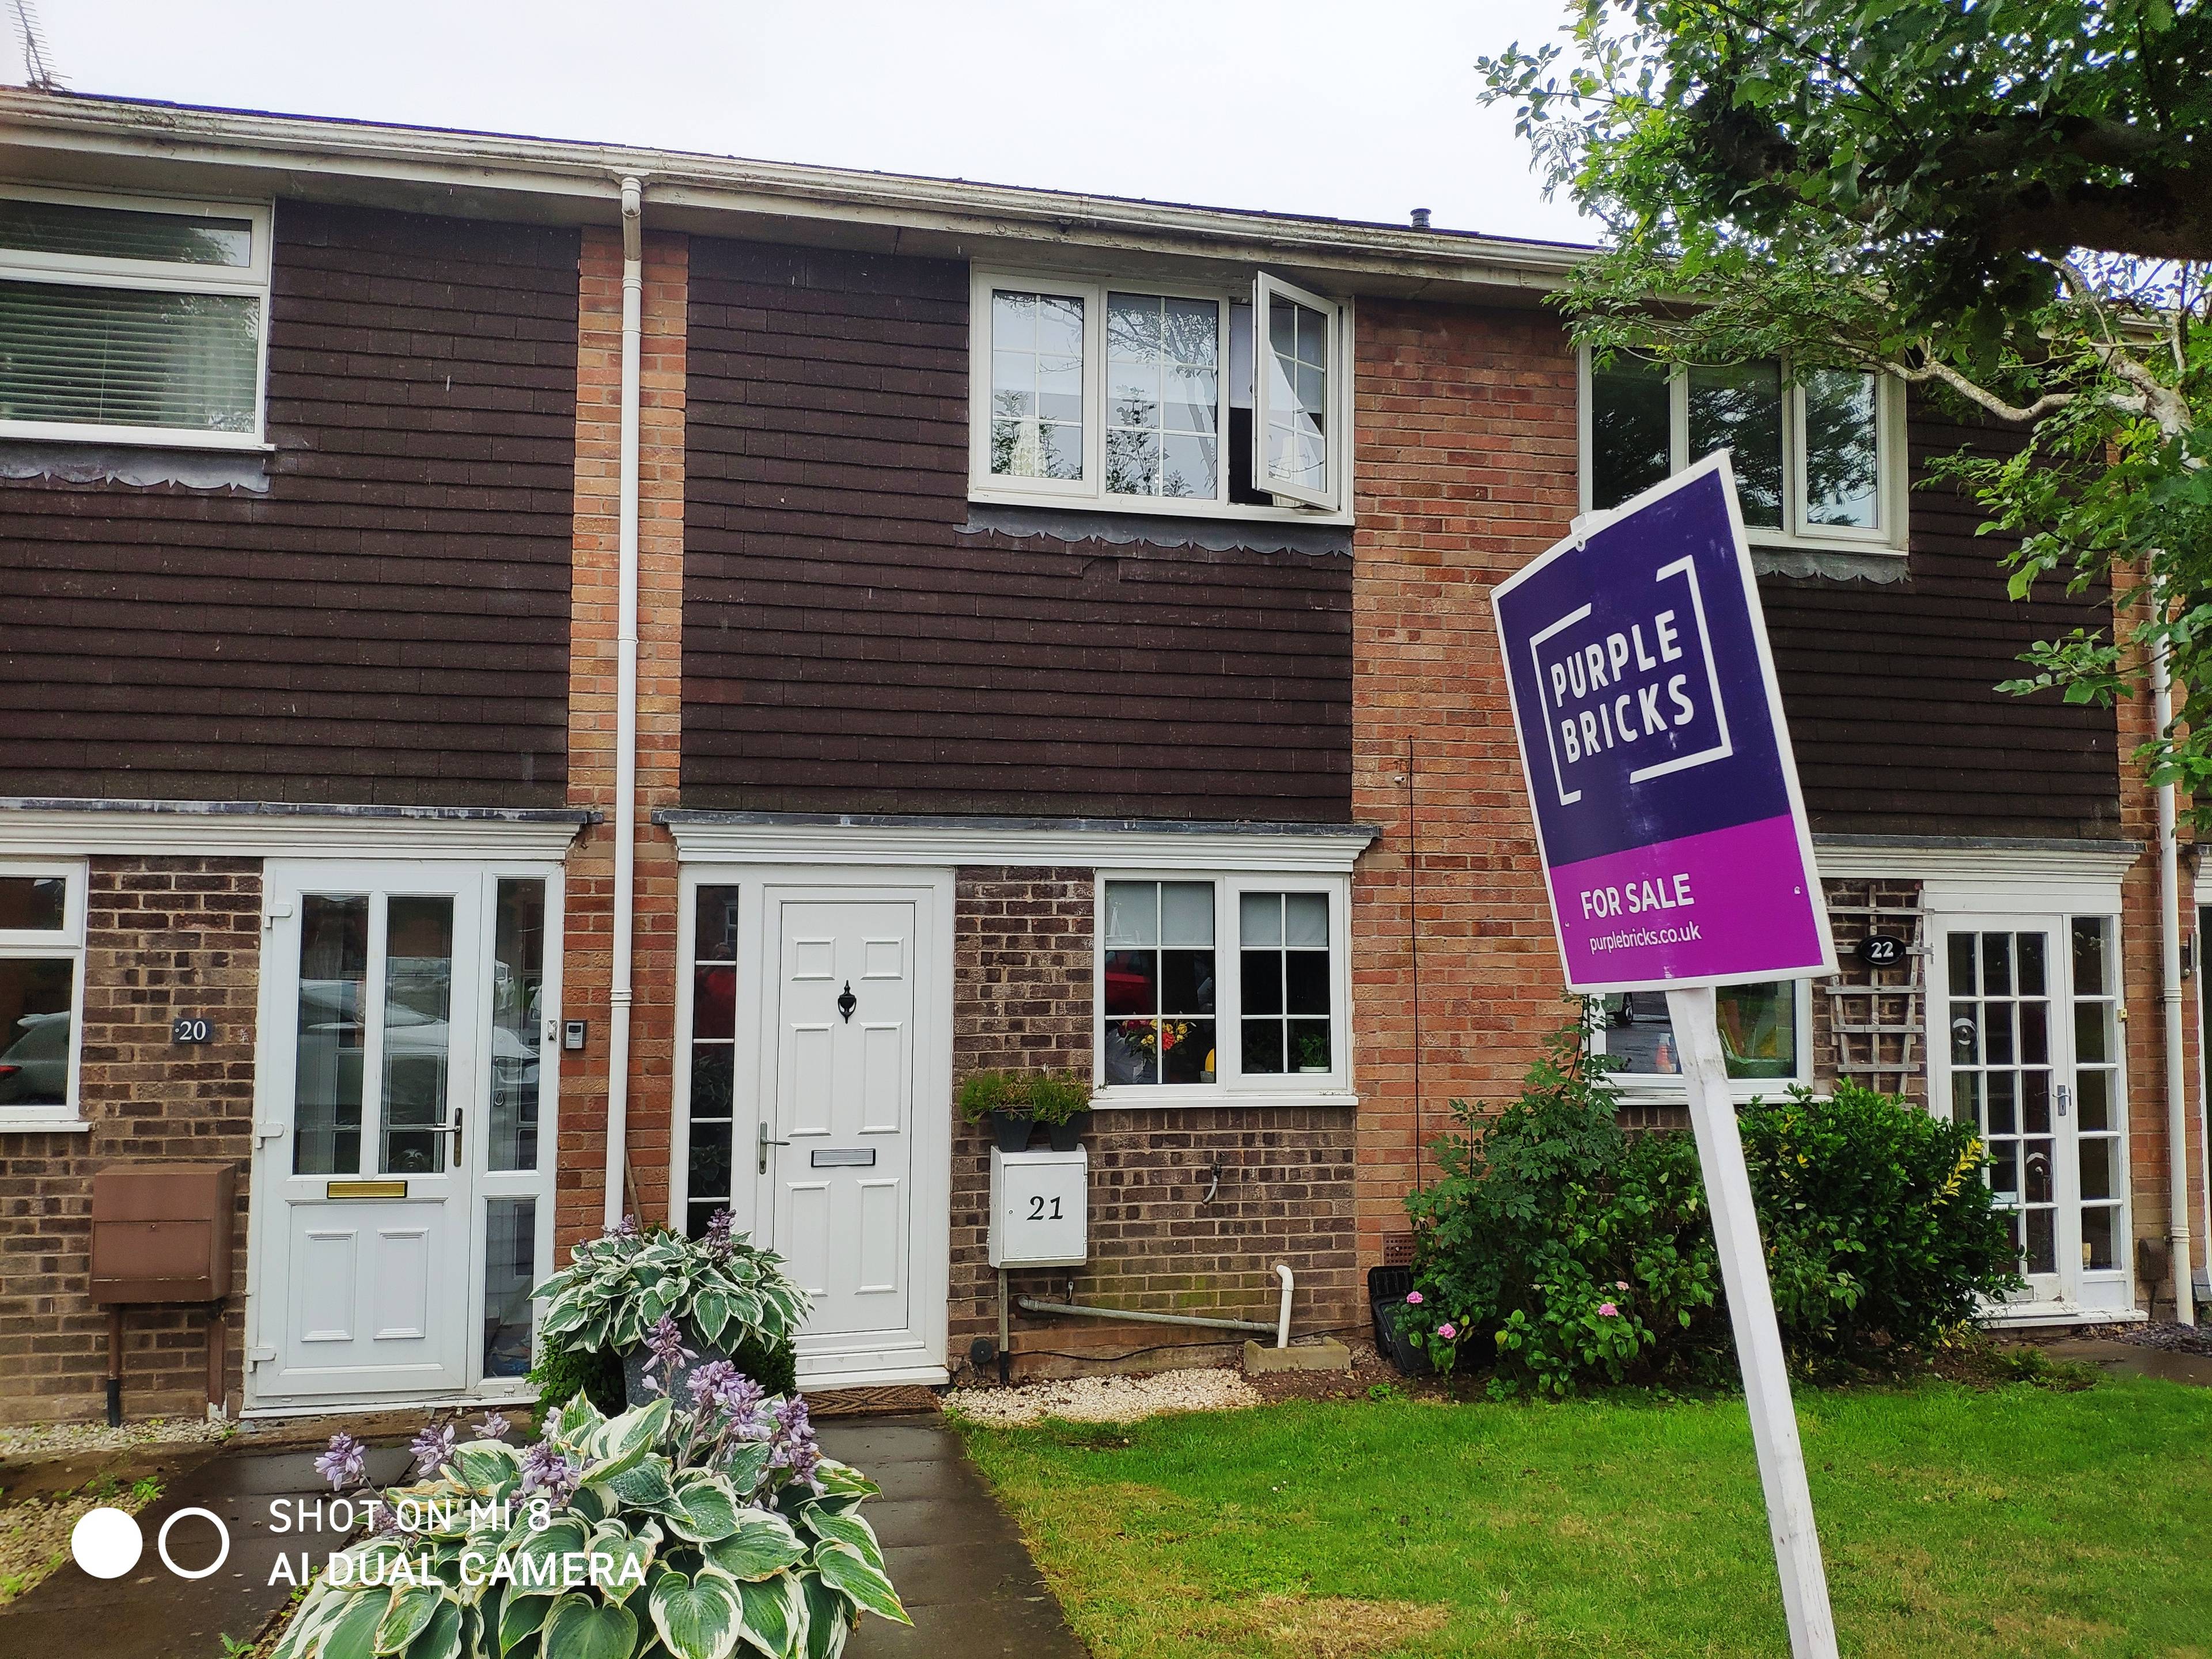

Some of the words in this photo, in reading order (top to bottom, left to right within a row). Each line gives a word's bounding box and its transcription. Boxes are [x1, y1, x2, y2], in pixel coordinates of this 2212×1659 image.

[1550, 609, 1683, 707] PURPLE
[1560, 675, 1695, 764] BRICKS
[1580, 885, 1623, 920] FOR
[1625, 873, 1695, 913] SALE
[1589, 921, 1702, 955] purplebricks.co.uk
[1871, 941, 1894, 959] 22
[179, 1021, 206, 1040] 20
[1026, 1195, 1063, 1221] 21
